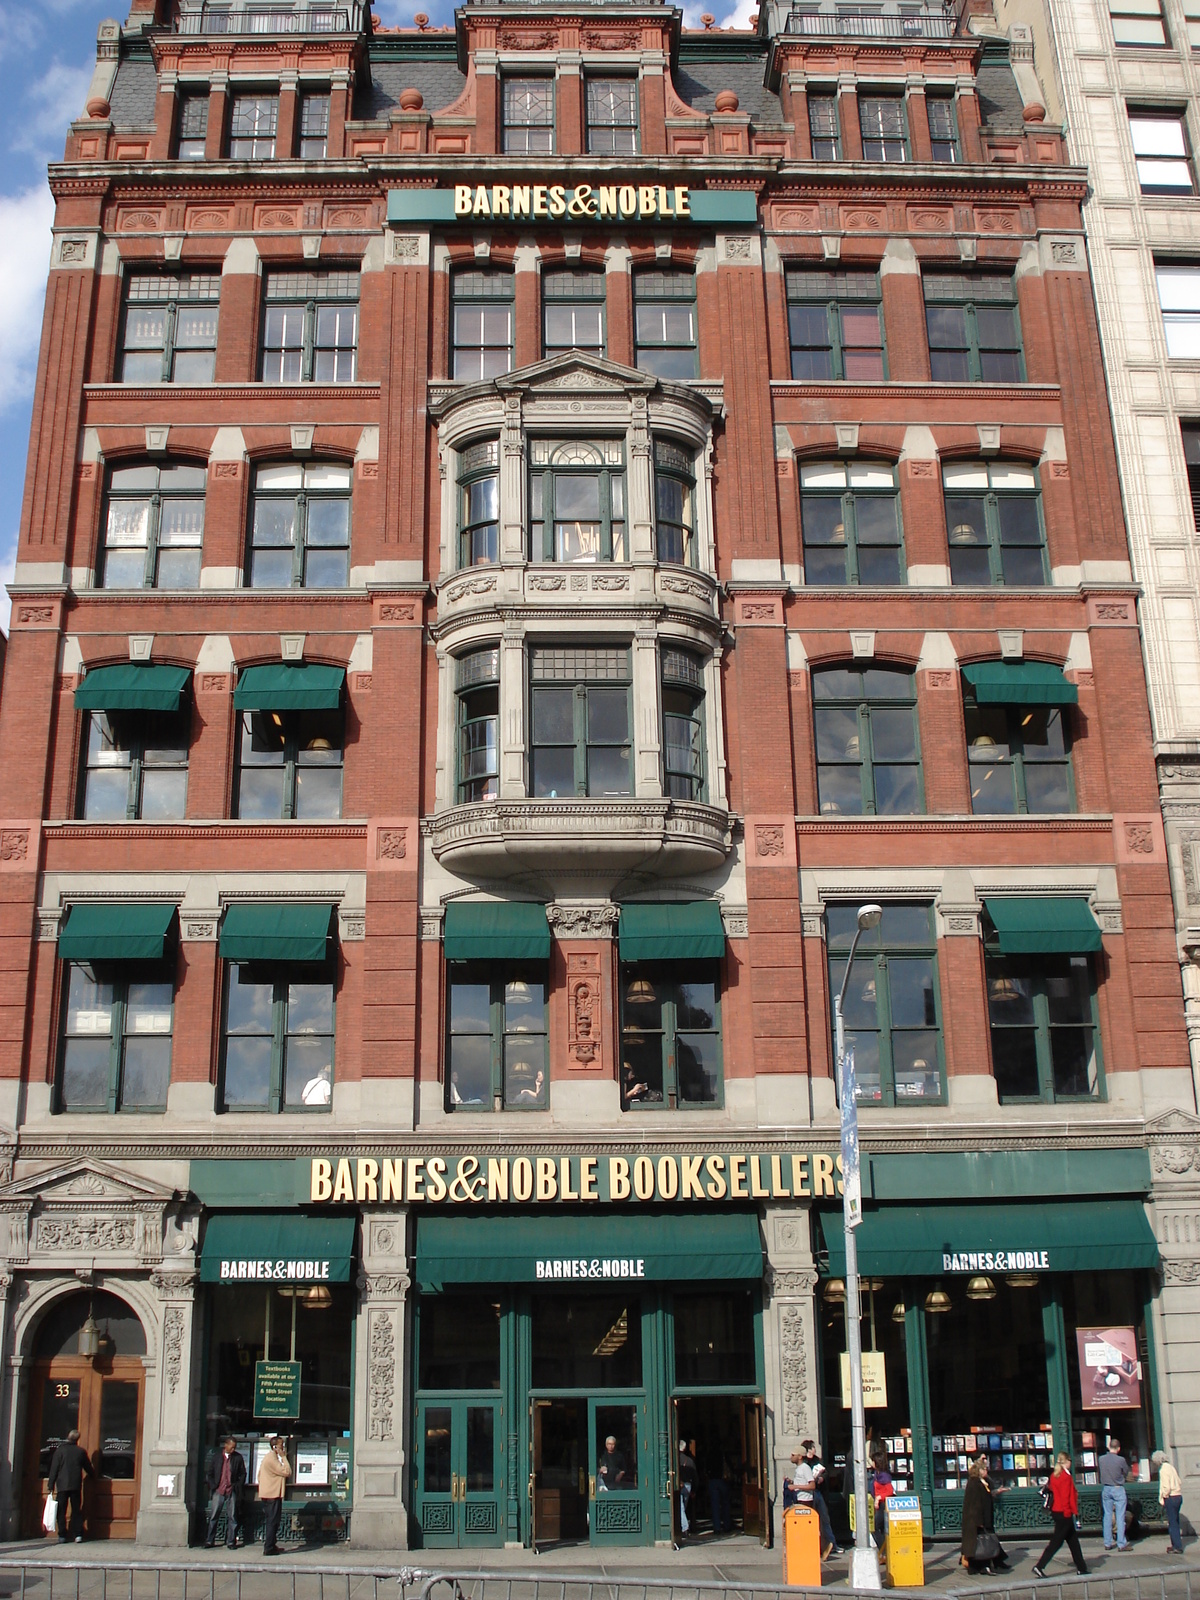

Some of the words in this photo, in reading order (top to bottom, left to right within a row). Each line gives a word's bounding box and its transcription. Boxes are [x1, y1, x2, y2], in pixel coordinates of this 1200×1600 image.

[454, 184, 691, 218] BARNES&NOBLE
[310, 1156, 599, 1202] BARNES&NOBLE
[220, 1260, 330, 1279] BARNES&NOBLE
[536, 1259, 645, 1278] BARNES&NOBLE
[943, 1251, 1050, 1271] BARNES&NOBLE
[55, 1384, 70, 1398] 33
[888, 1498, 918, 1510] Epoch
